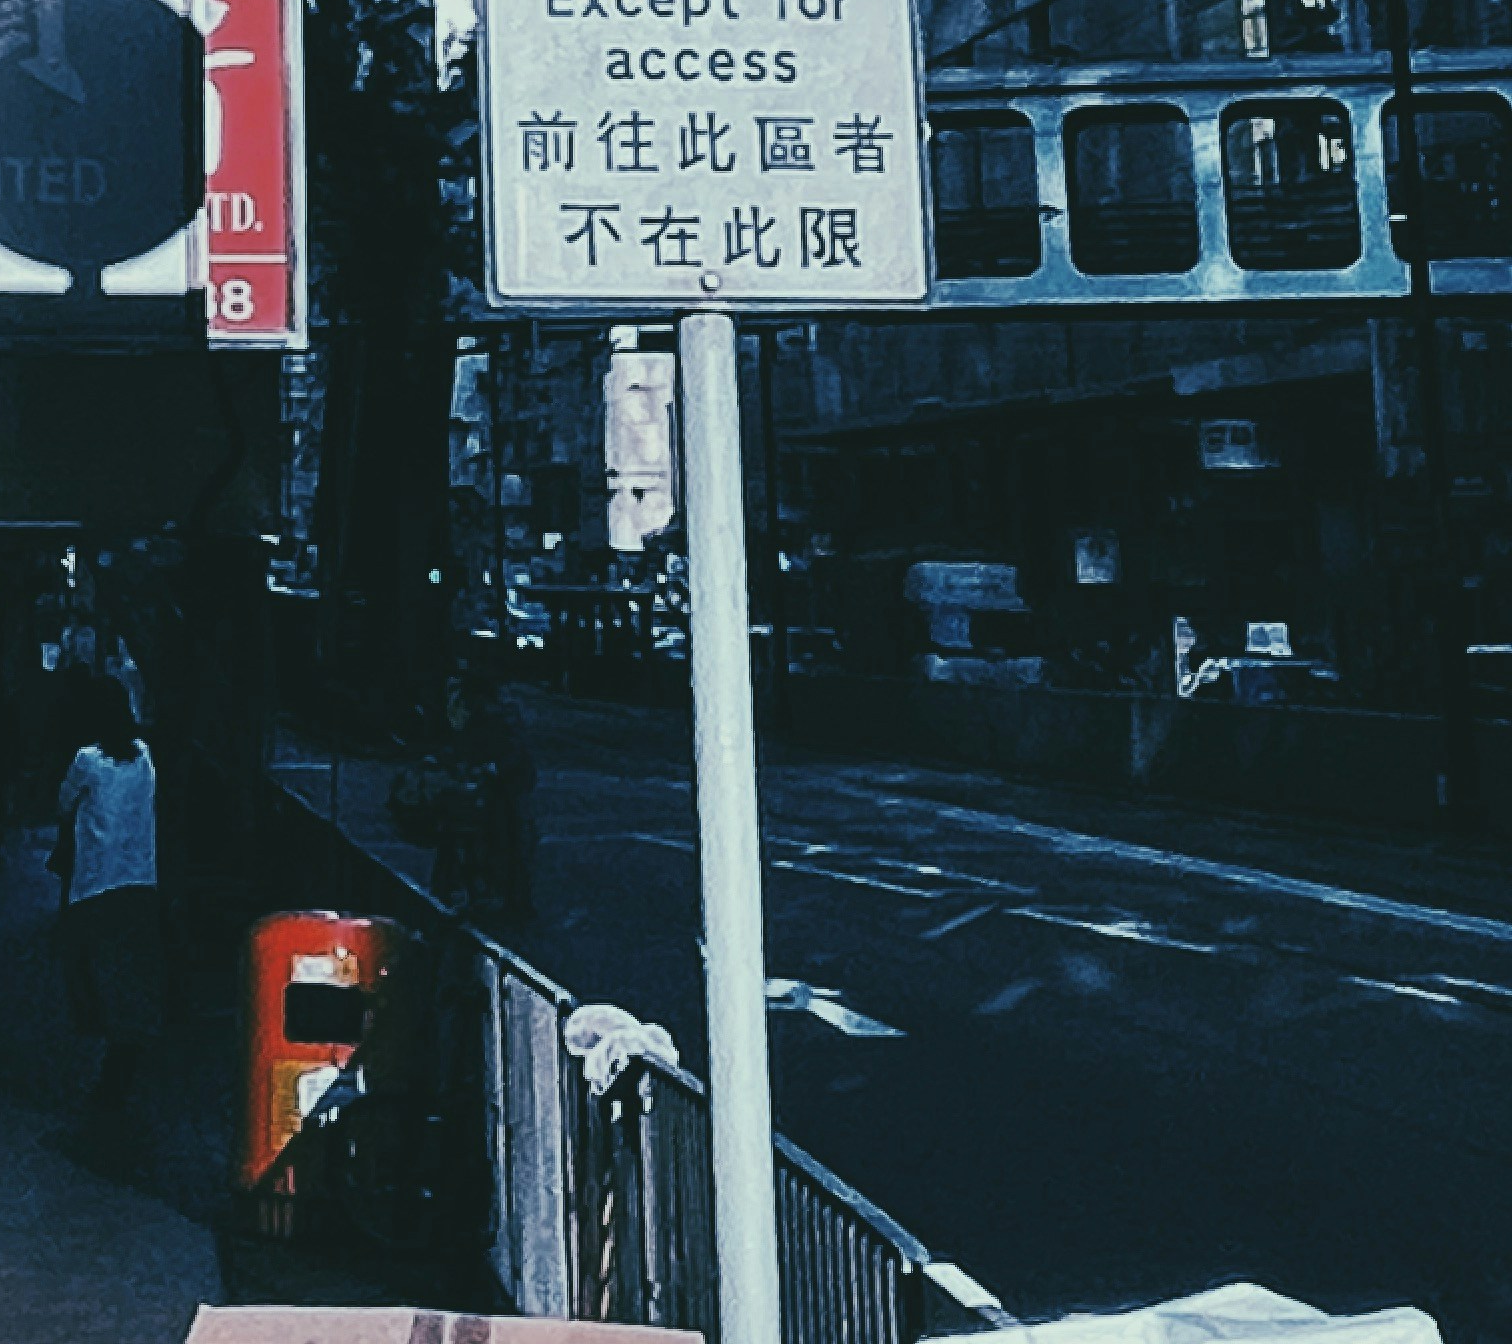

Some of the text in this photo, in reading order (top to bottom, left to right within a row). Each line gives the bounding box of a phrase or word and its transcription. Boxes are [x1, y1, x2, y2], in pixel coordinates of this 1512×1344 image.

[604, 45, 799, 84] access
[517, 110, 895, 175] 前往此區者
[207, 191, 264, 233] TD.
[559, 202, 863, 269] 不在此限
